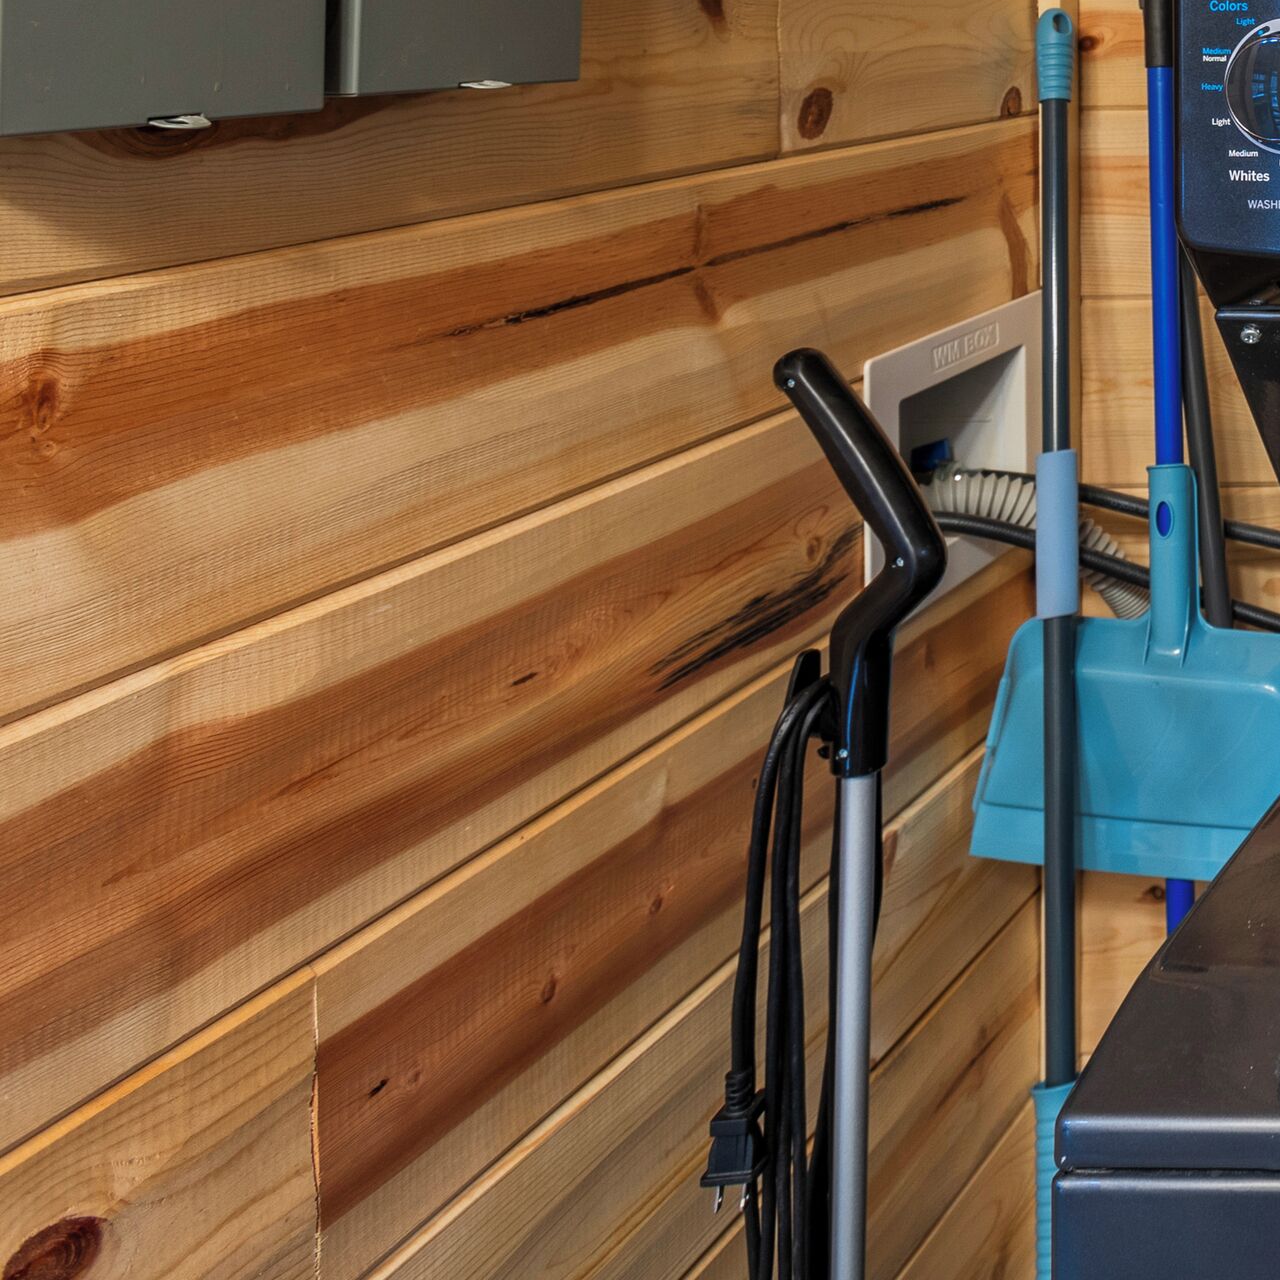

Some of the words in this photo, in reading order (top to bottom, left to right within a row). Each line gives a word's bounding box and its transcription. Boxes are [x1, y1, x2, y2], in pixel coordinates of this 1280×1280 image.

[1210, 0, 1248, 12] Colors
[1236, 17, 1255, 26] Light
[1201, 83, 1224, 92] Heavy
[1212, 118, 1231, 127] Light
[1229, 150, 1258, 158] Medium
[1229, 170, 1270, 182] Whites
